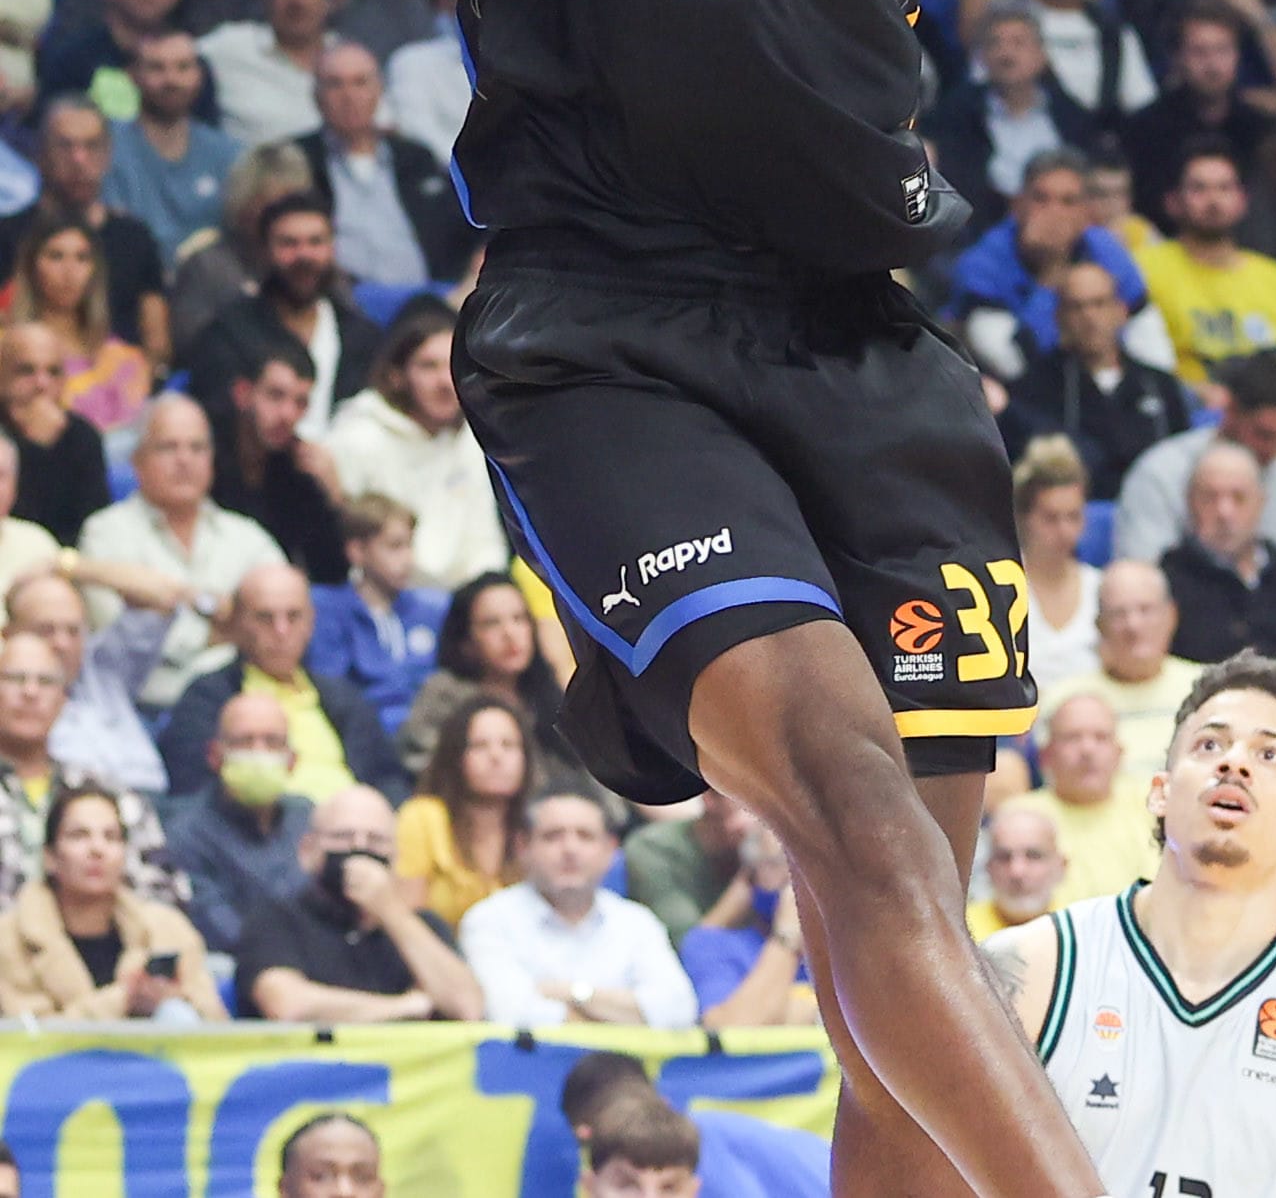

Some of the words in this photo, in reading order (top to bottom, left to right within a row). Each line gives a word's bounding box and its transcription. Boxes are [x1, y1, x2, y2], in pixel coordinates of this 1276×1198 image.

[638, 527, 733, 585] Rapyd
[893, 653, 943, 664] TURKISH
[893, 663, 944, 673] AIRLINES
